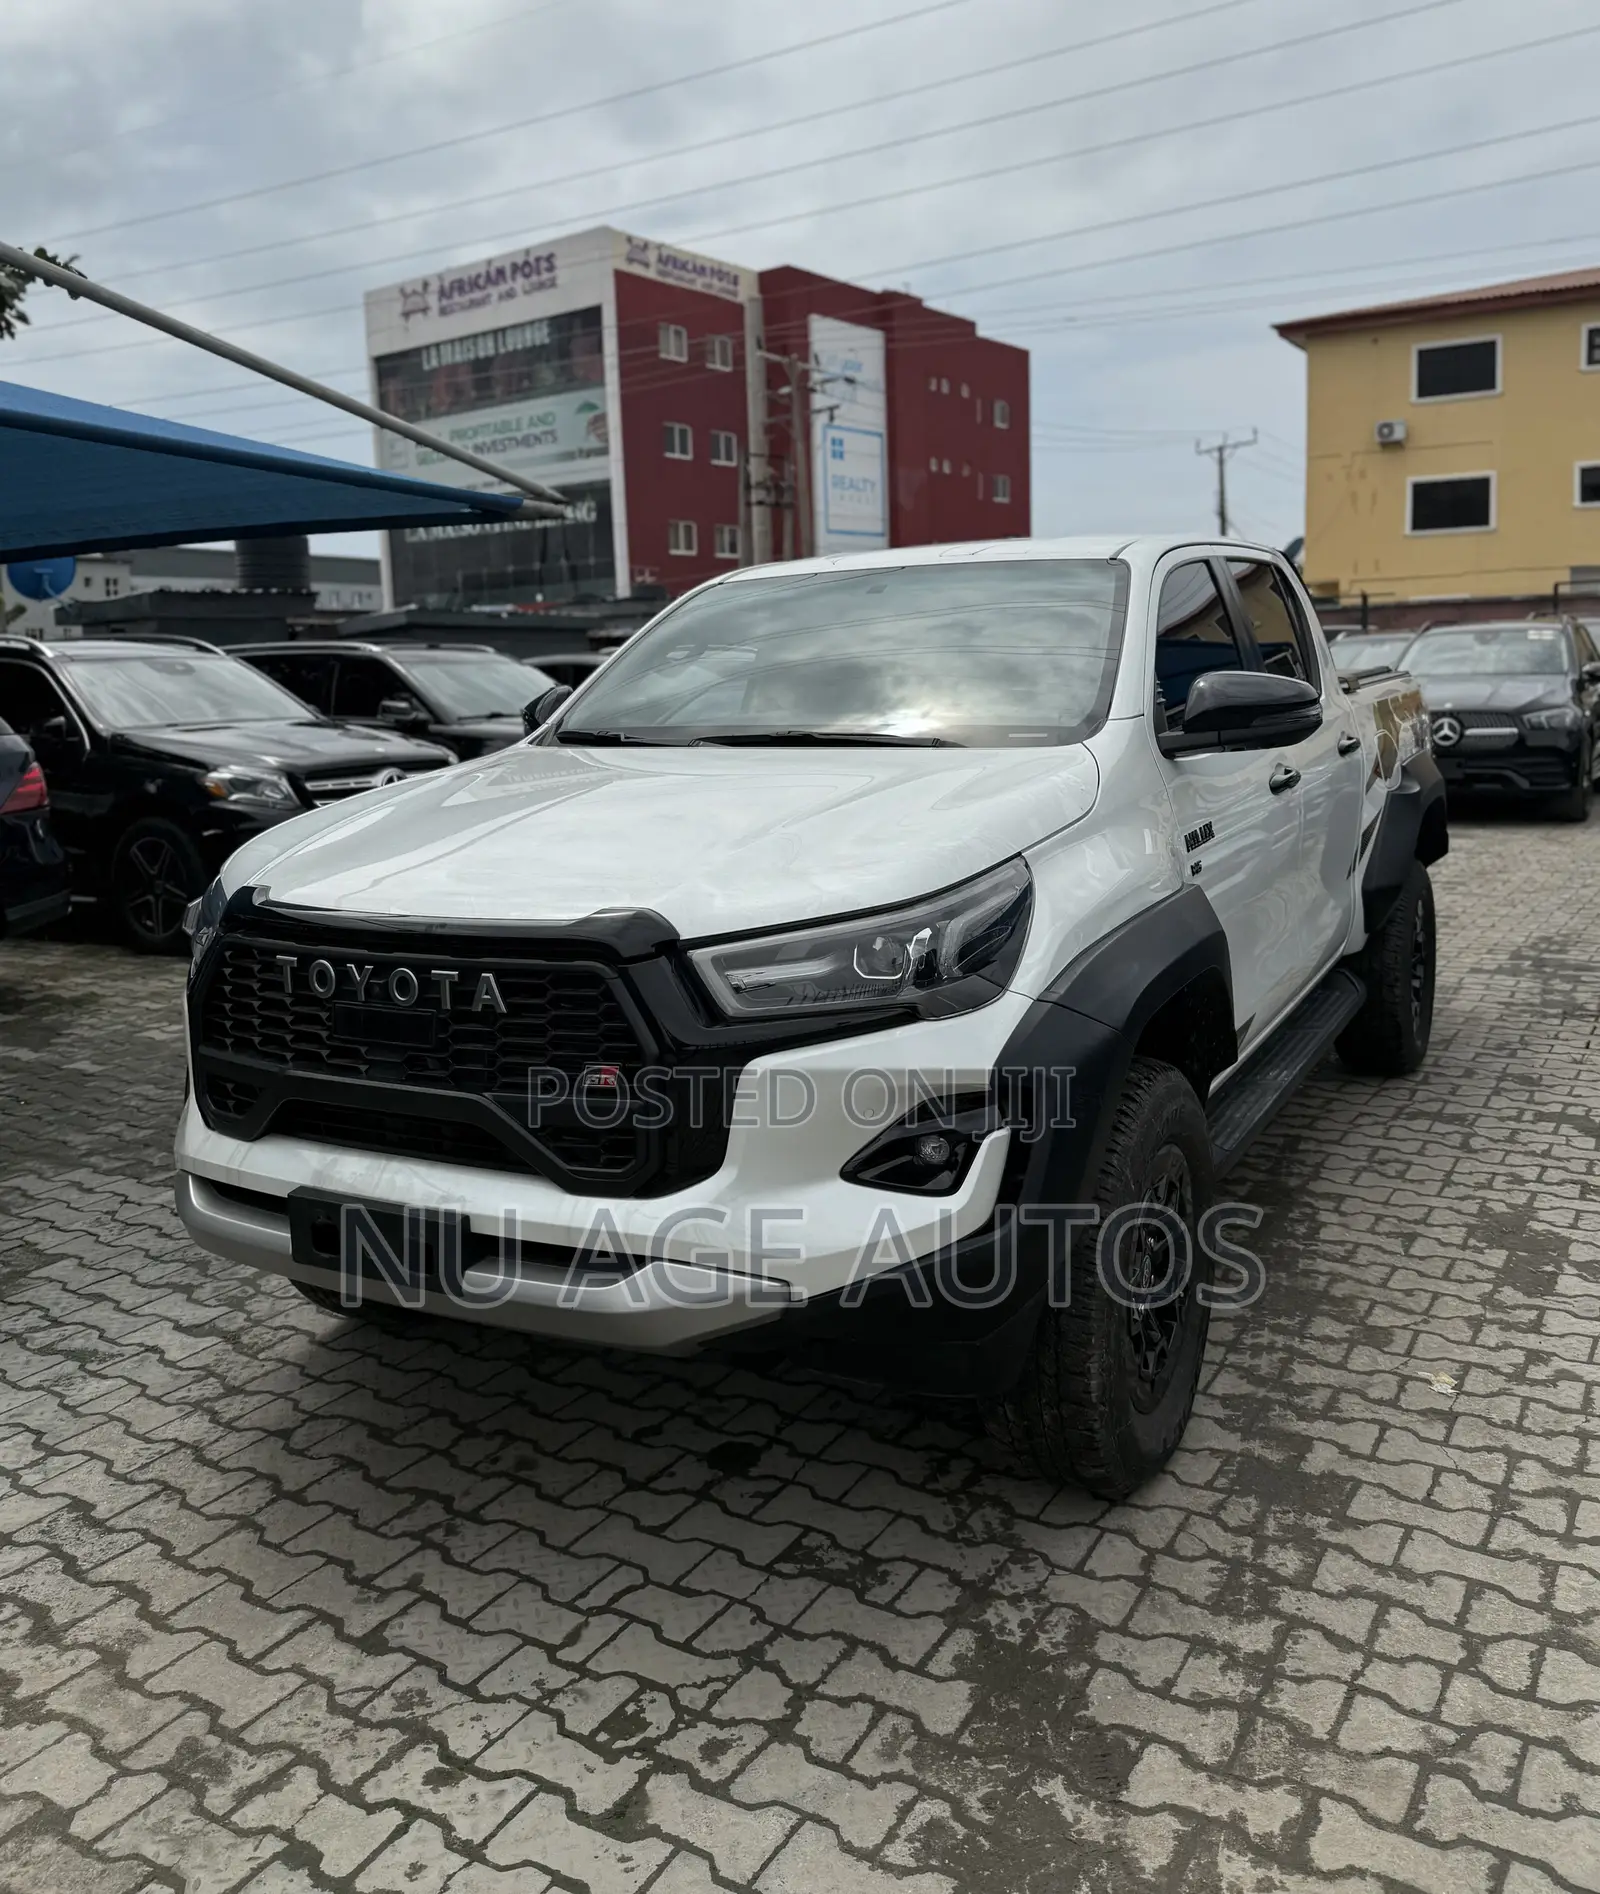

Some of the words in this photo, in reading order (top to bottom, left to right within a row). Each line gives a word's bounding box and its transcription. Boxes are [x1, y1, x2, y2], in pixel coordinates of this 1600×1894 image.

[449, 414, 522, 442] PROFITABLE
[527, 410, 557, 428] AND
[472, 428, 558, 456] INVESTMENTS
[831, 473, 877, 493] REALTY
[1184, 820, 1215, 853] HILUX
[276, 955, 508, 1014] TOYOTA
